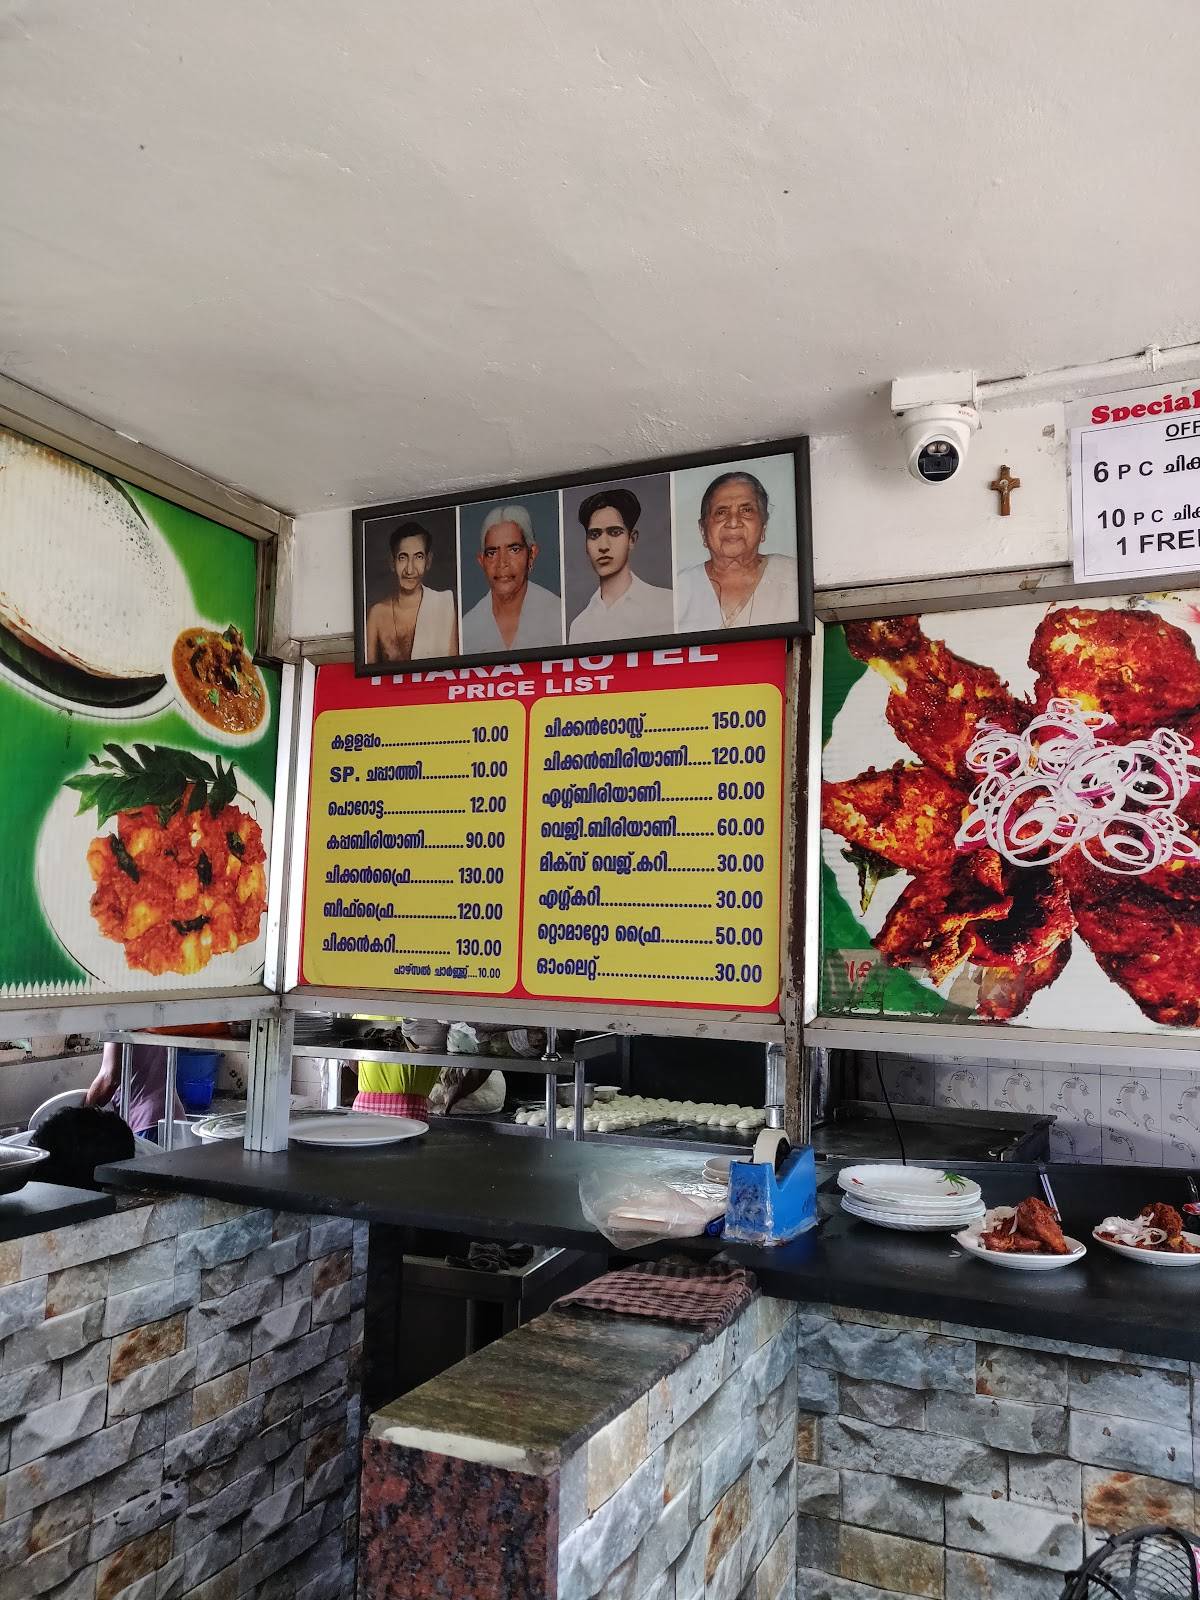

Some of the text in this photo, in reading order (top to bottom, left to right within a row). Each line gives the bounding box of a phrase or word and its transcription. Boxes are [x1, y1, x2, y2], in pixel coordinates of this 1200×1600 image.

[1091, 389, 1200, 425] Special
[1093, 461, 1109, 483] 6
[1097, 508, 1126, 529] 10
[1116, 528, 1200, 556] 1 FRE
[448, 674, 615, 700] PRICE LIST
[711, 709, 767, 730] 150.00
[472, 726, 509, 742] 10.00
[711, 746, 766, 765] 120.00
[330, 766, 360, 783] SP.
[471, 761, 508, 778] 10.00
[717, 781, 765, 800] 80.00
[470, 796, 506, 813] 12.00
[717, 818, 765, 836] 60.00
[466, 832, 505, 849] 90.00
[716, 854, 765, 872] 30.00
[458, 867, 504, 884] 130.00
[716, 890, 763, 909] 30.00
[457, 902, 503, 920] 120.00
[715, 926, 763, 945] 50.00
[456, 938, 502, 956] 130.00
[477, 968, 501, 979] 10.00
[714, 963, 762, 983] 30.00
